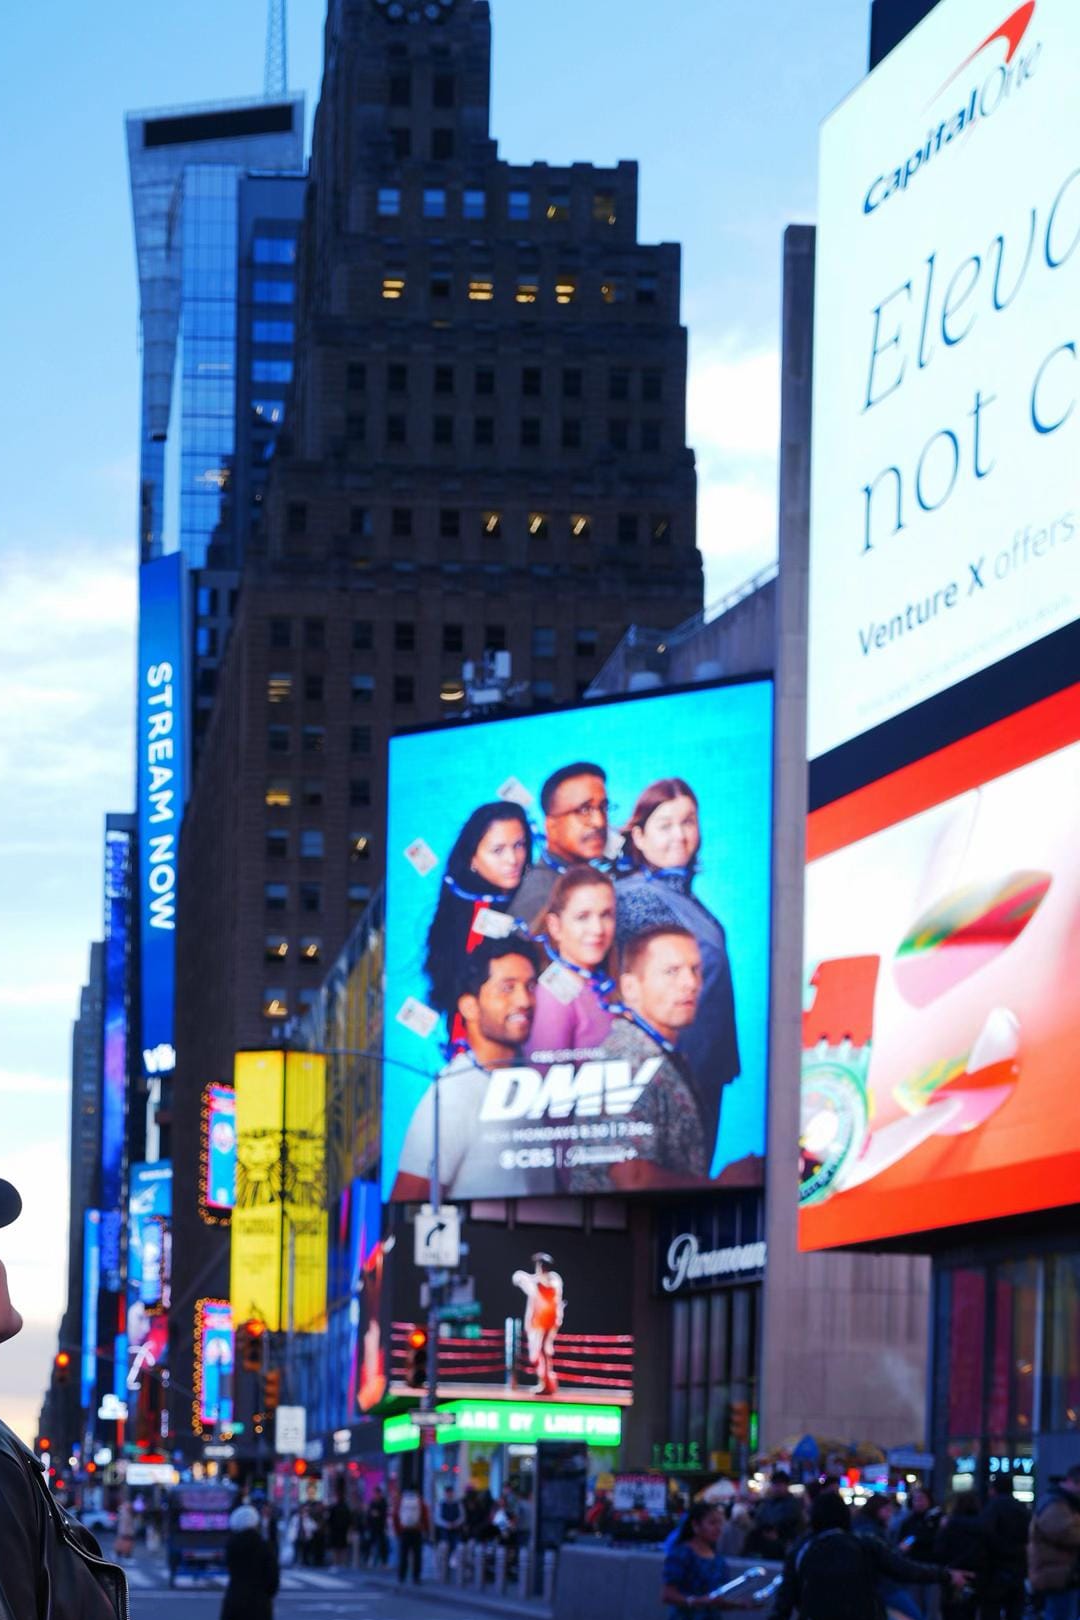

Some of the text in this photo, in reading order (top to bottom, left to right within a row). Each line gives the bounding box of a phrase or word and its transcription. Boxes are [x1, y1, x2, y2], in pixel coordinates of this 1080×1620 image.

[861, 390, 996, 555] not
[859, 582, 958, 656] Venture
[968, 556, 985, 597] X
[147, 662, 175, 930] STREAM NOW
[480, 1056, 664, 1121] DMV
